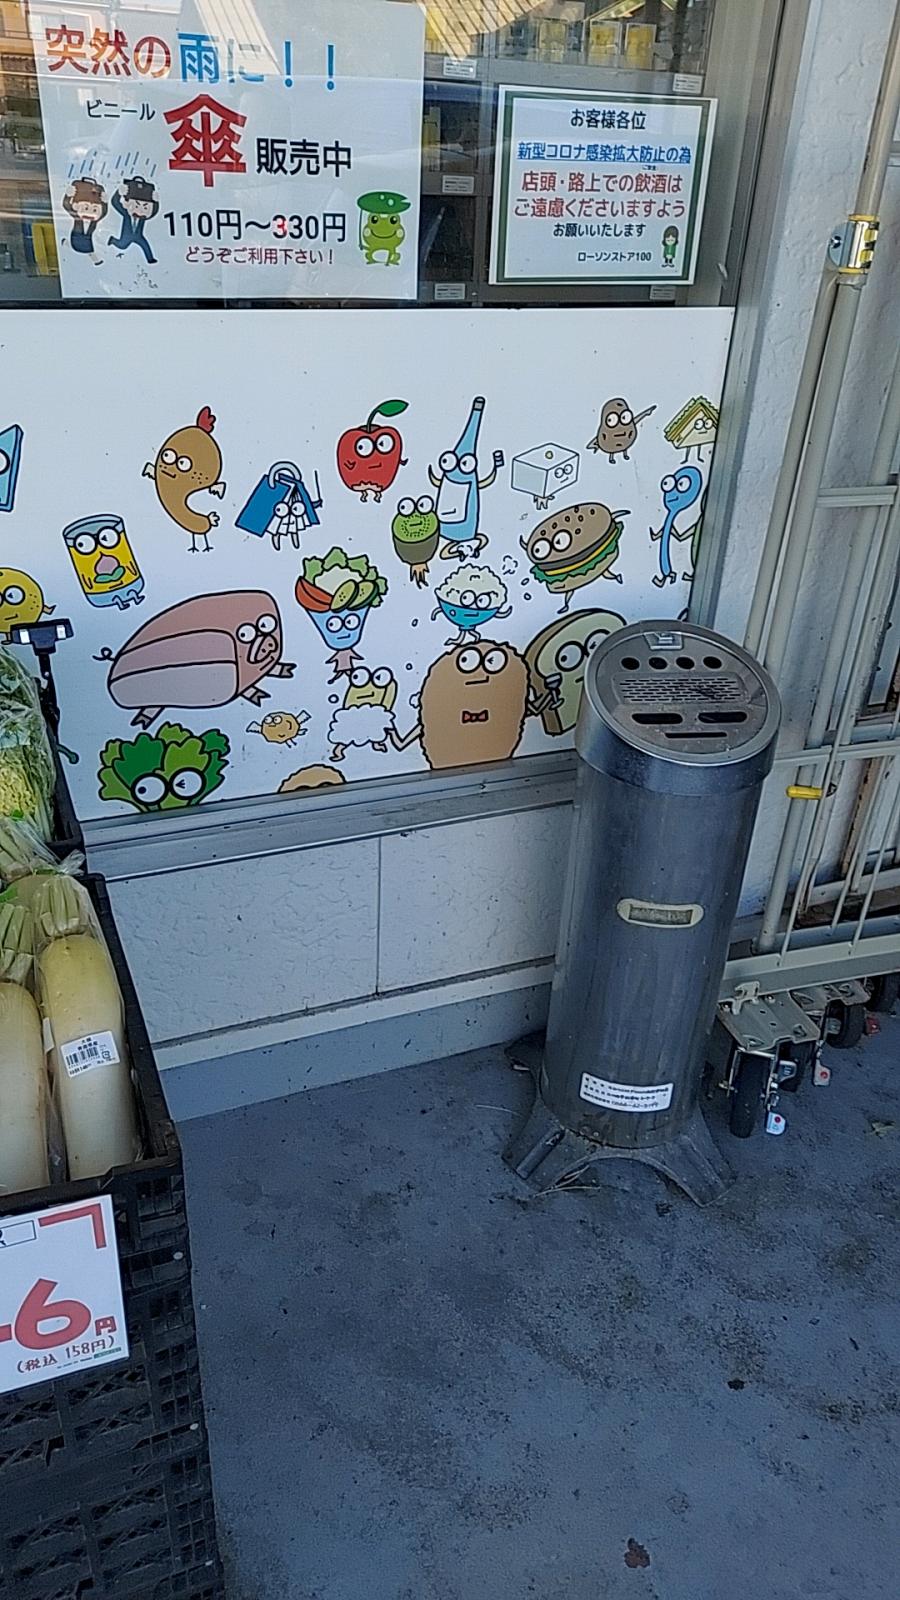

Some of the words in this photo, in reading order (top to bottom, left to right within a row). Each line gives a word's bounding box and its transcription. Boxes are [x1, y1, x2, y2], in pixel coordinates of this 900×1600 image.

[570, 108, 647, 130] お客様各位
[86, 100, 156, 121] ビニール
[163, 93, 248, 187] 傘
[256, 138, 352, 178] 販売中
[517, 142, 692, 165] 新型コロナ感染拡大防止の為
[521, 170, 683, 194] 店頭・路上での飲酒は
[514, 197, 685, 218] ご遠慮くださいますよう
[553, 222, 646, 238] お願いいたします
[185, 247, 335, 265] どうぞご利用下さい！
[577, 251, 652, 262] ローソンストア100
